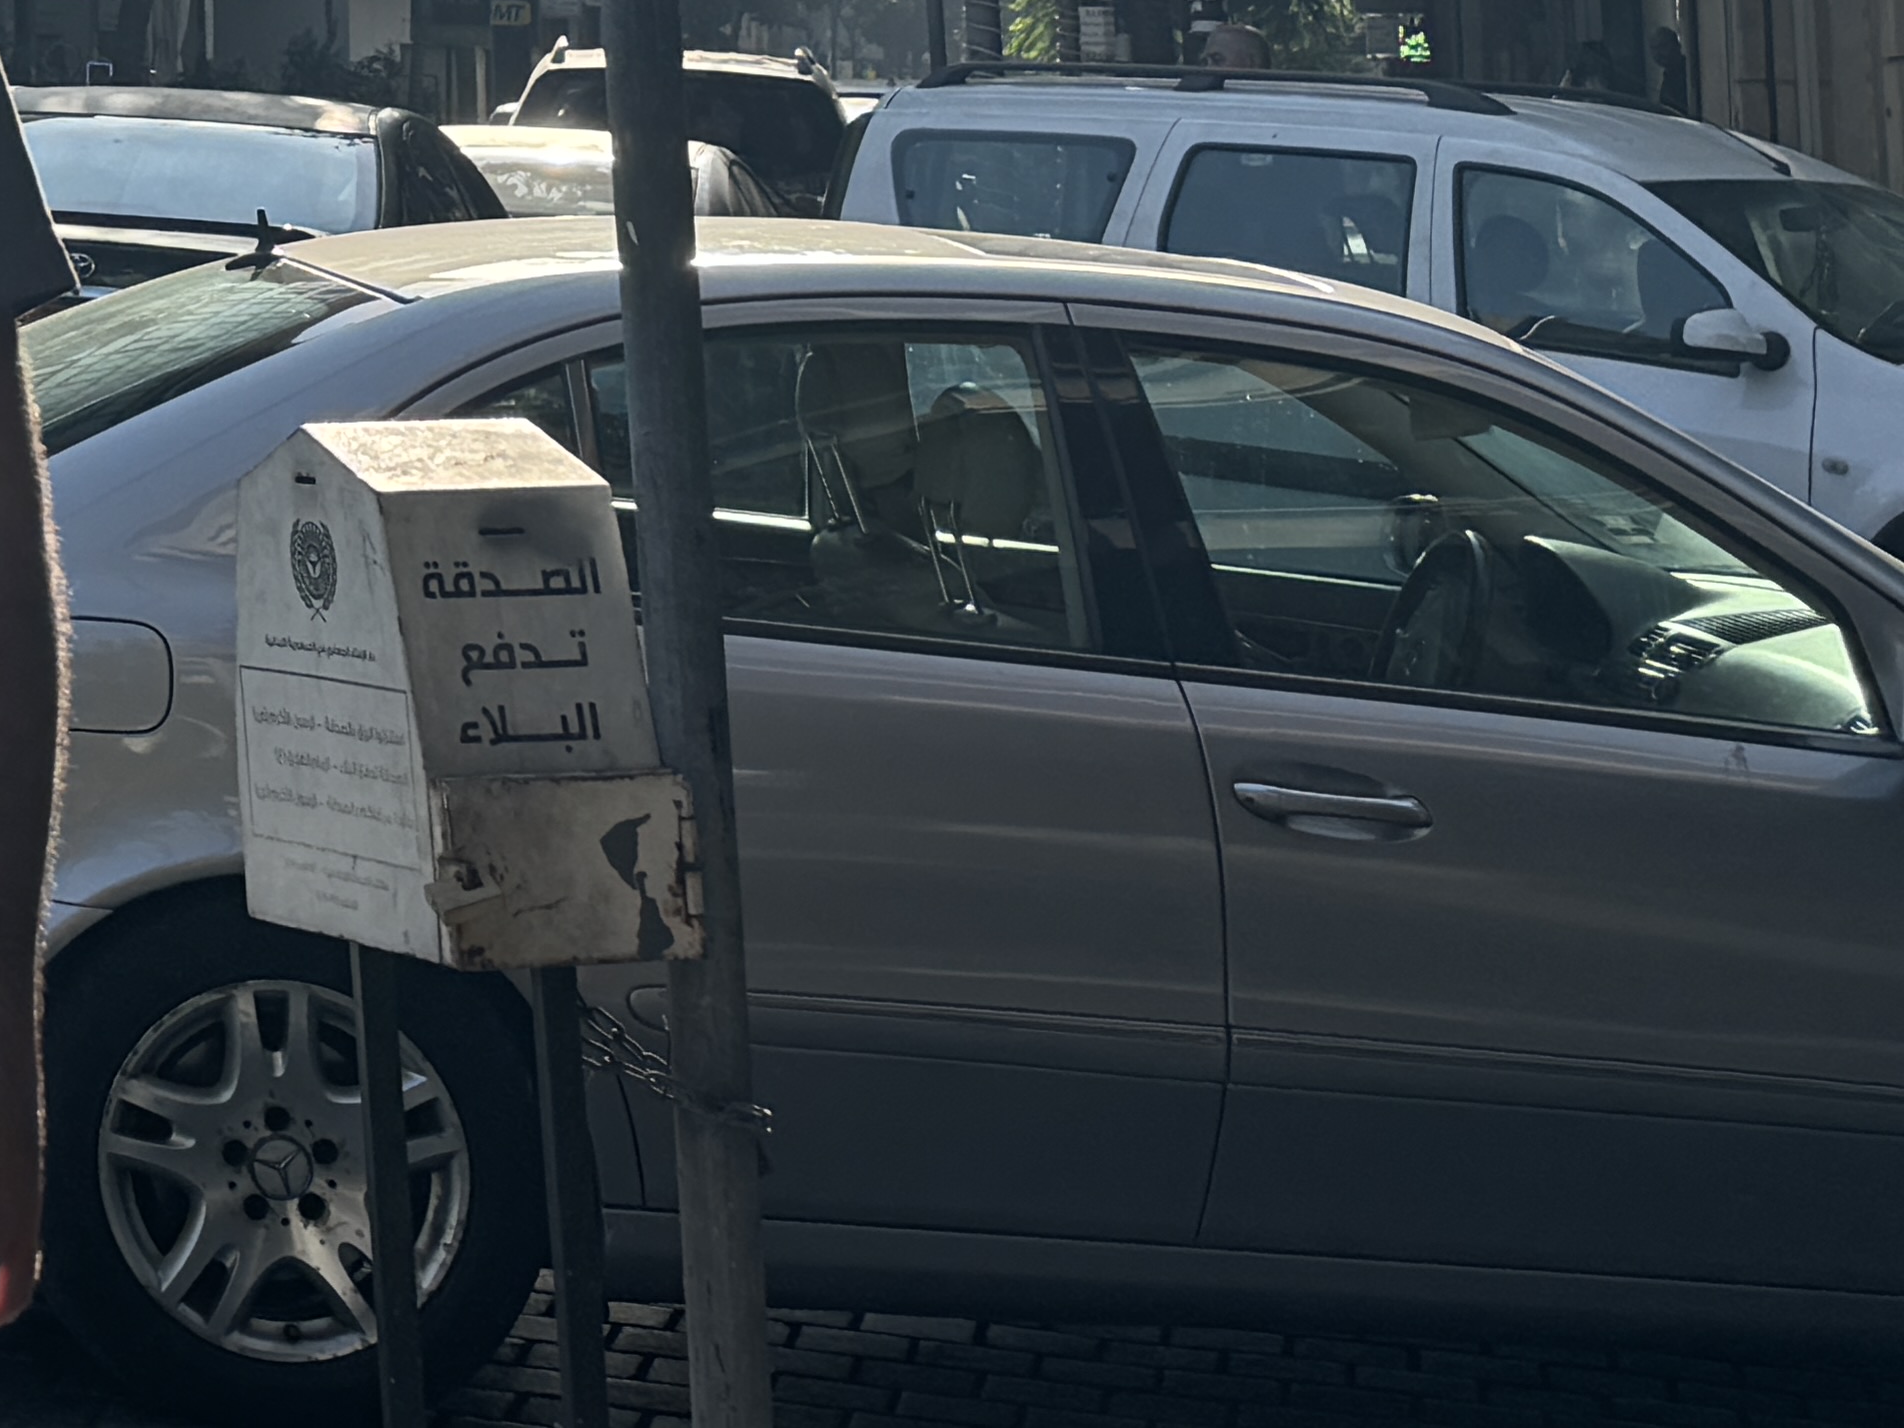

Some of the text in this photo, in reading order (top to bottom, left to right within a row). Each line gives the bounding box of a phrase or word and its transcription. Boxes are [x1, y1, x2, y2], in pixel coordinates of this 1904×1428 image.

[422, 557, 602, 601] الصدقة
[460, 629, 590, 686] تدفع
[459, 702, 602, 753] البلاء
